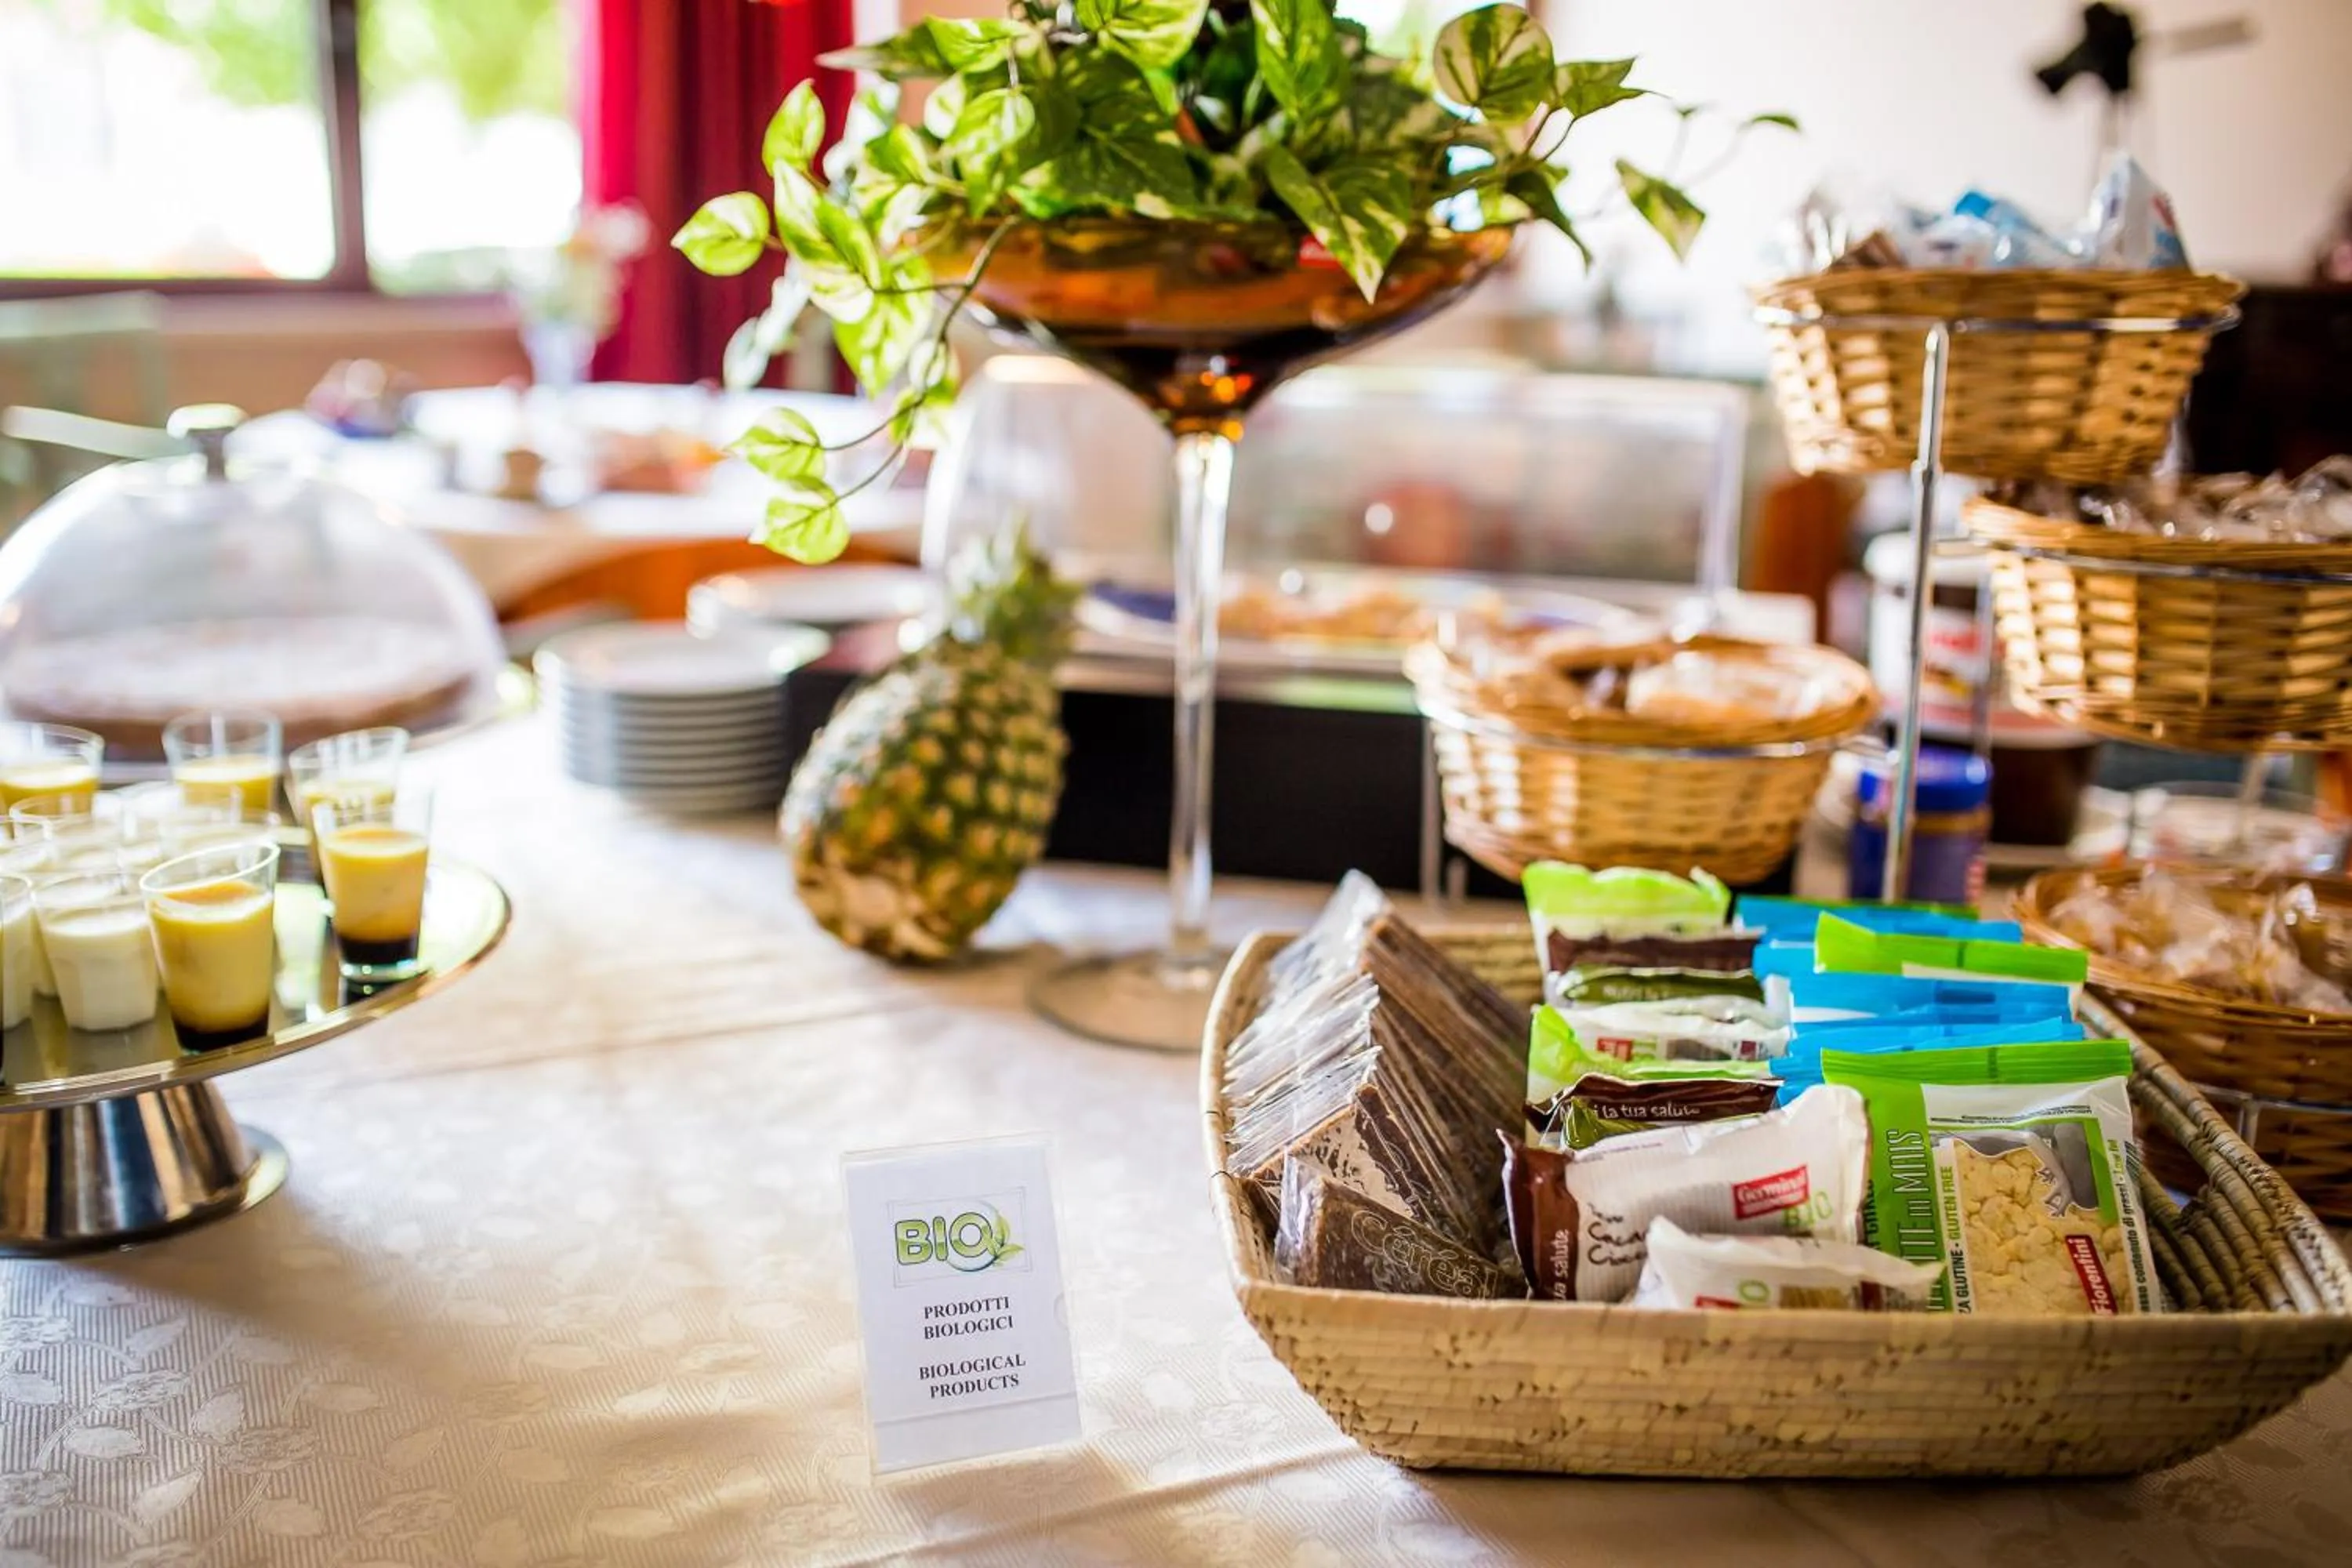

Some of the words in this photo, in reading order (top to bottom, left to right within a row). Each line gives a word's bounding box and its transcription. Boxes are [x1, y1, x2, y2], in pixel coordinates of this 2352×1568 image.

[1602, 1104, 1618, 1119] la
[1621, 1104, 1647, 1118] tua
[1886, 1128, 1929, 1192] MAIS
[1940, 1166, 1956, 1192] FREE
[1944, 1196, 1961, 1240] GLUTEN
[895, 1211, 994, 1265] BIO
[1550, 1229, 1569, 1279] salute
[1950, 1249, 1971, 1298] GLUTINE
[2067, 1238, 2114, 1315] Fiorentini
[924, 1296, 1010, 1319] PRODOTTI
[924, 1316, 1014, 1340] BIOLOGICI
[919, 1353, 1026, 1381] BIOLOGICAL
[930, 1374, 1019, 1399] PRODUCTS
